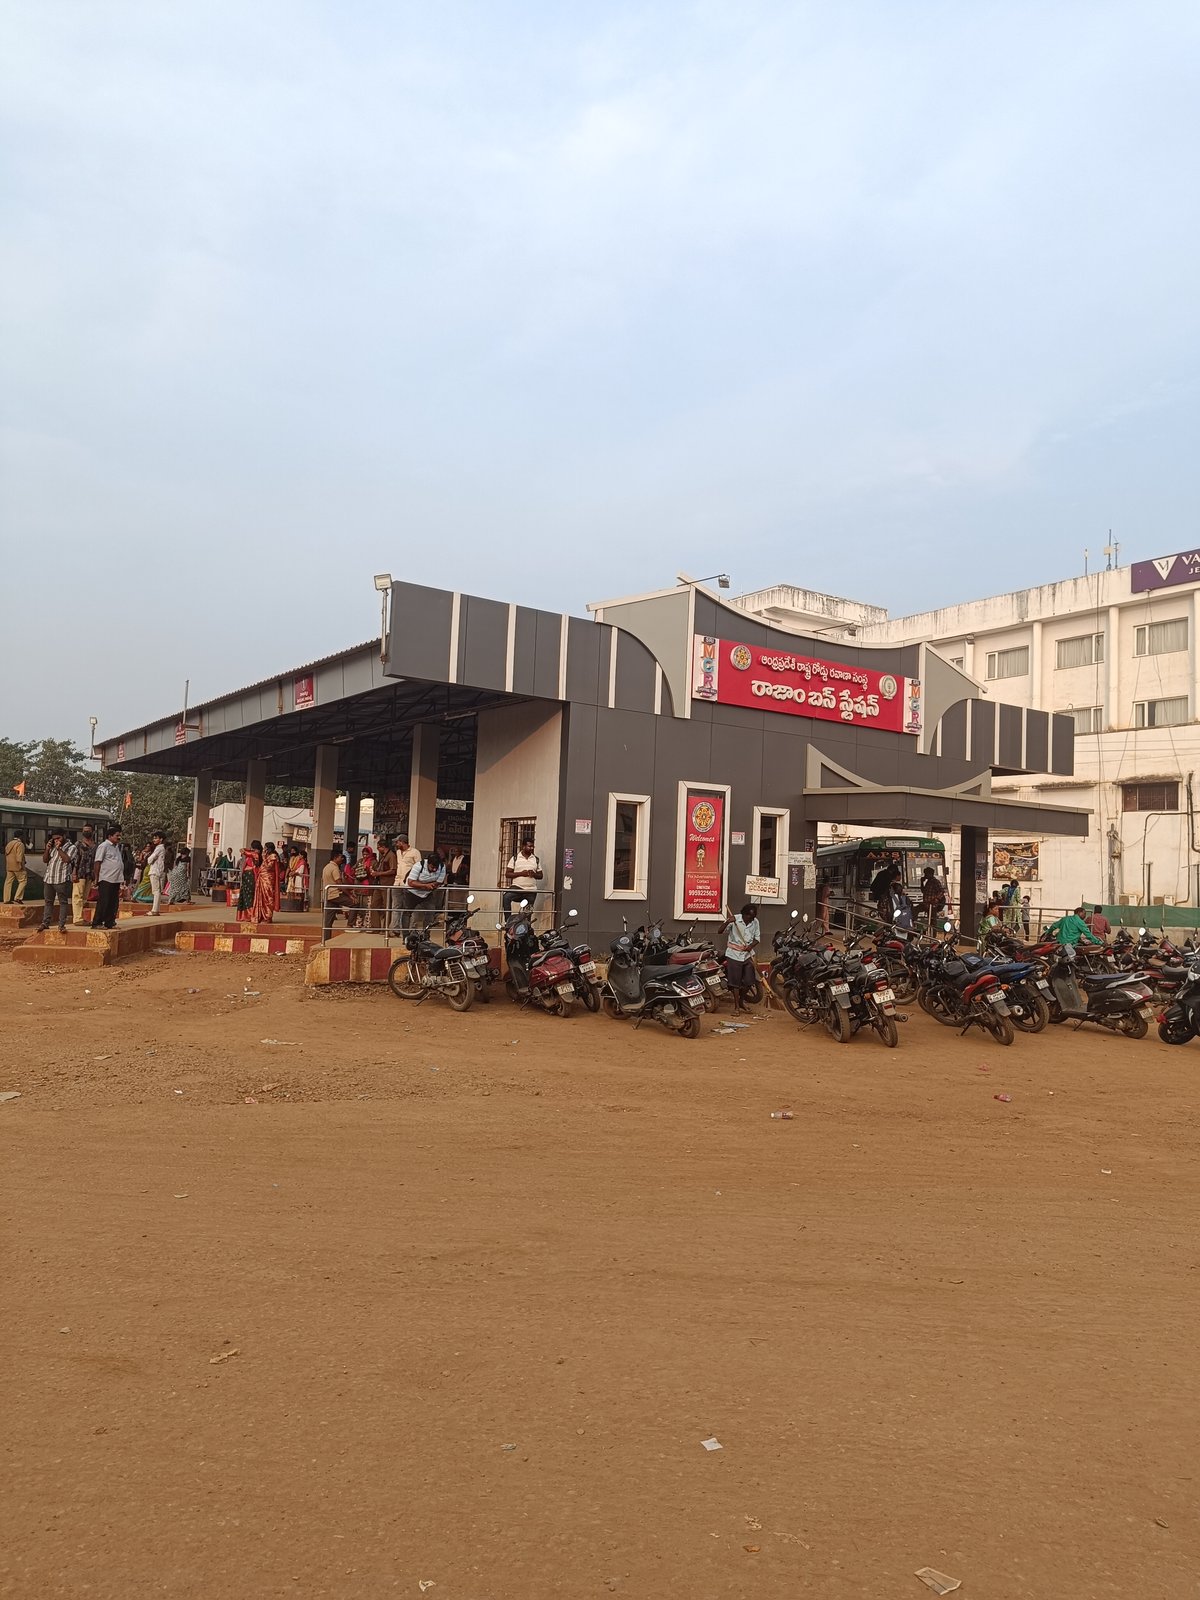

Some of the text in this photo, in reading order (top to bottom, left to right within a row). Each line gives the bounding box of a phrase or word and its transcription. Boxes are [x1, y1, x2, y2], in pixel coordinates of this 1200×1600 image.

[796, 662, 811, 680] రాష్ట్ర
[812, 662, 829, 681] రోడ్డు
[829, 668, 852, 680] రవాణా
[852, 671, 868, 690] సంస్థ
[751, 680, 880, 720] రాజాం బస్ స్టేషన్
[689, 833, 715, 843] Welcomes
